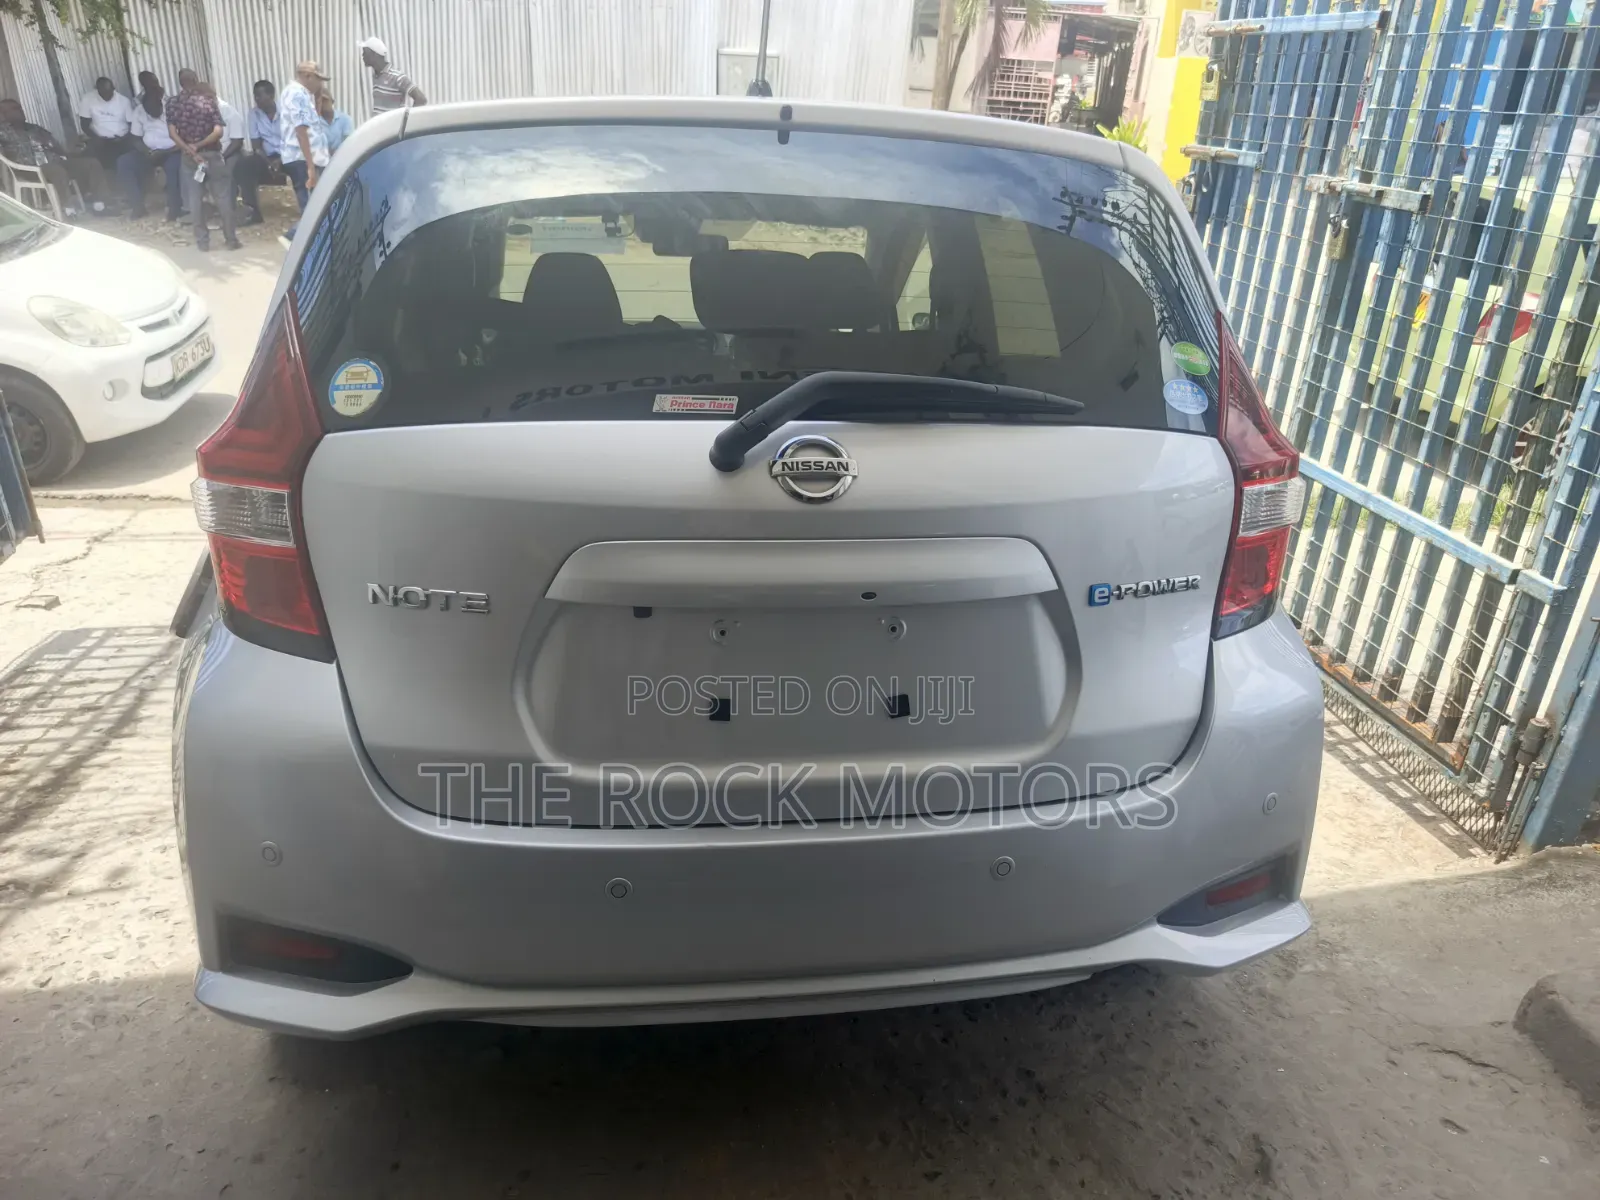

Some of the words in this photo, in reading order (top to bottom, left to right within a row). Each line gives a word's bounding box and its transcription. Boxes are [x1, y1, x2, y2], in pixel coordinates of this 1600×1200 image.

[669, 399, 706, 409] Prince
[708, 400, 735, 409] Nara
[781, 460, 849, 472] NISSAN
[366, 582, 491, 615] NOTE
[1088, 574, 1201, 607] e-POWER
